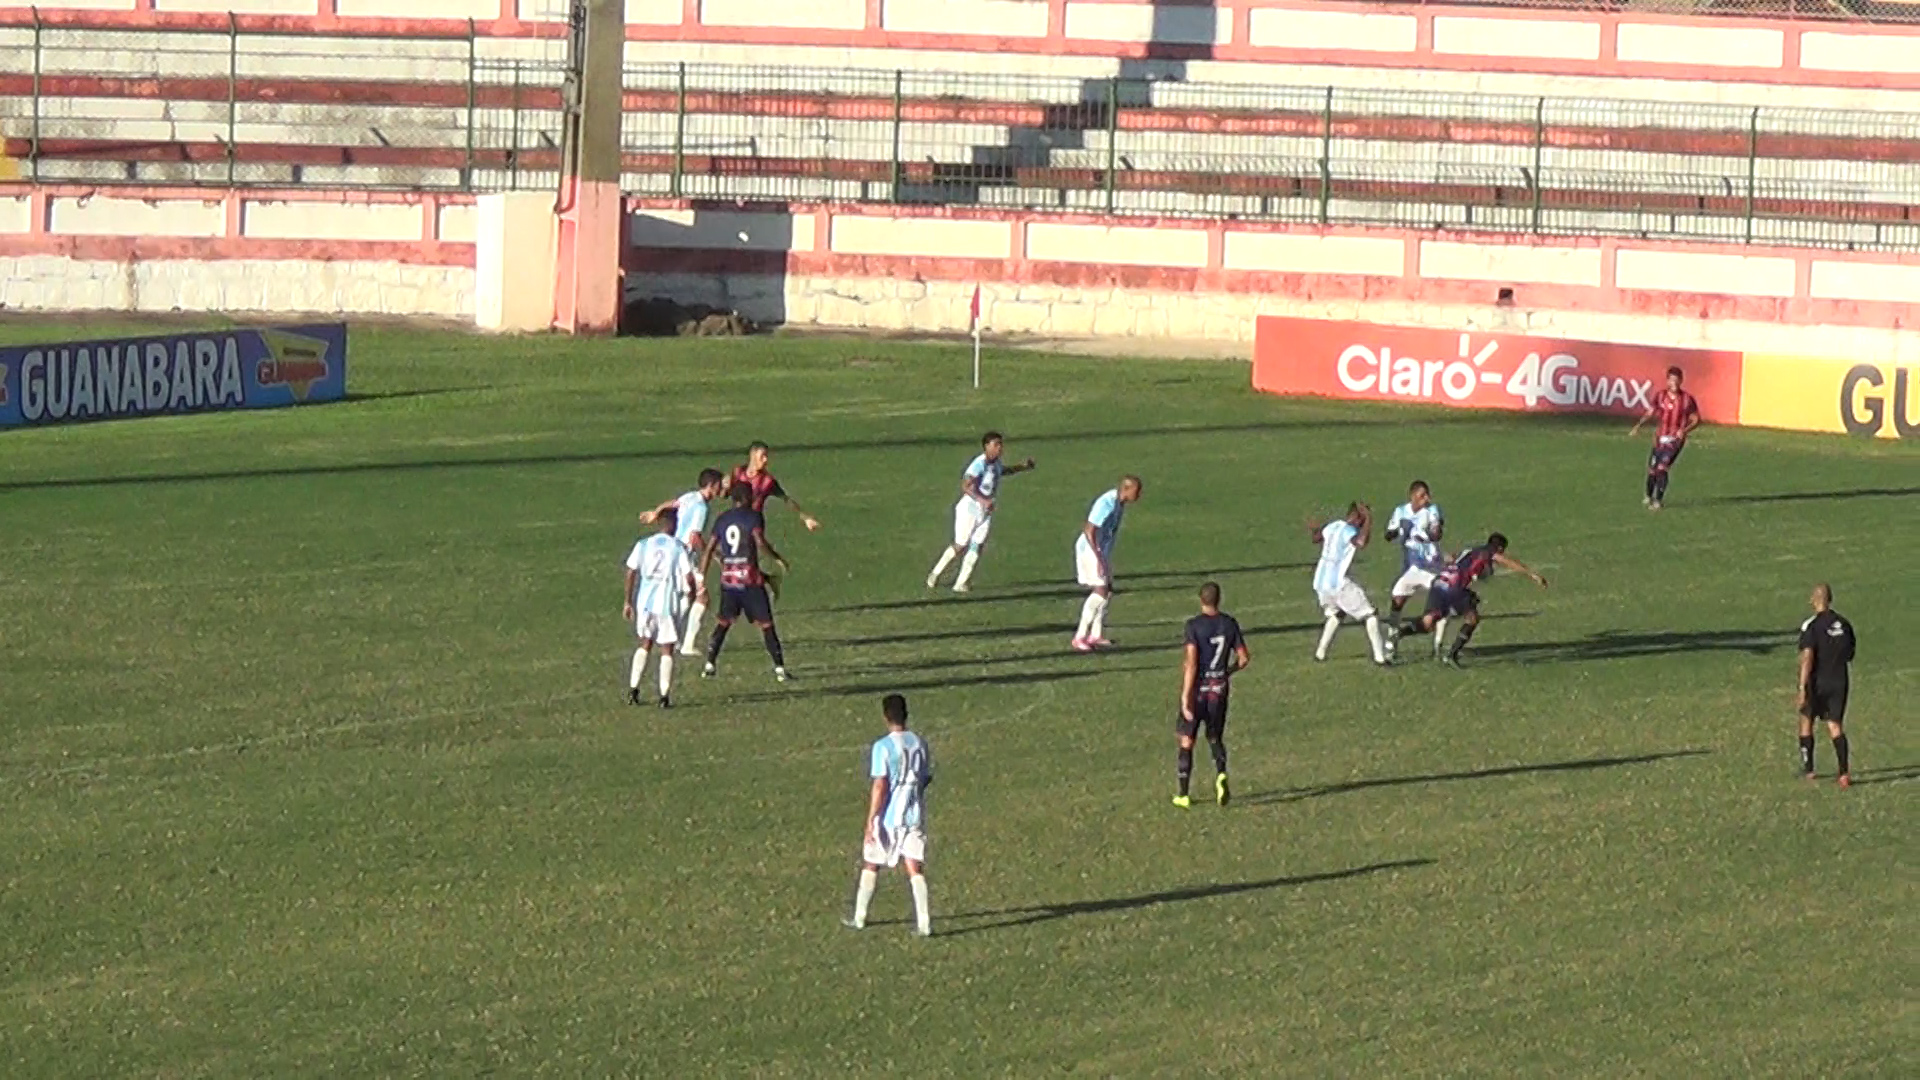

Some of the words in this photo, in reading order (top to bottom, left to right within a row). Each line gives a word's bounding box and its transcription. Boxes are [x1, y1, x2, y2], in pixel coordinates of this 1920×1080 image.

[21, 337, 243, 420] GUANABARA
[1337, 341, 1478, 400] Claro
[725, 524, 740, 555] 9
[646, 549, 668, 580] 2
[1209, 635, 1225, 669] 7
